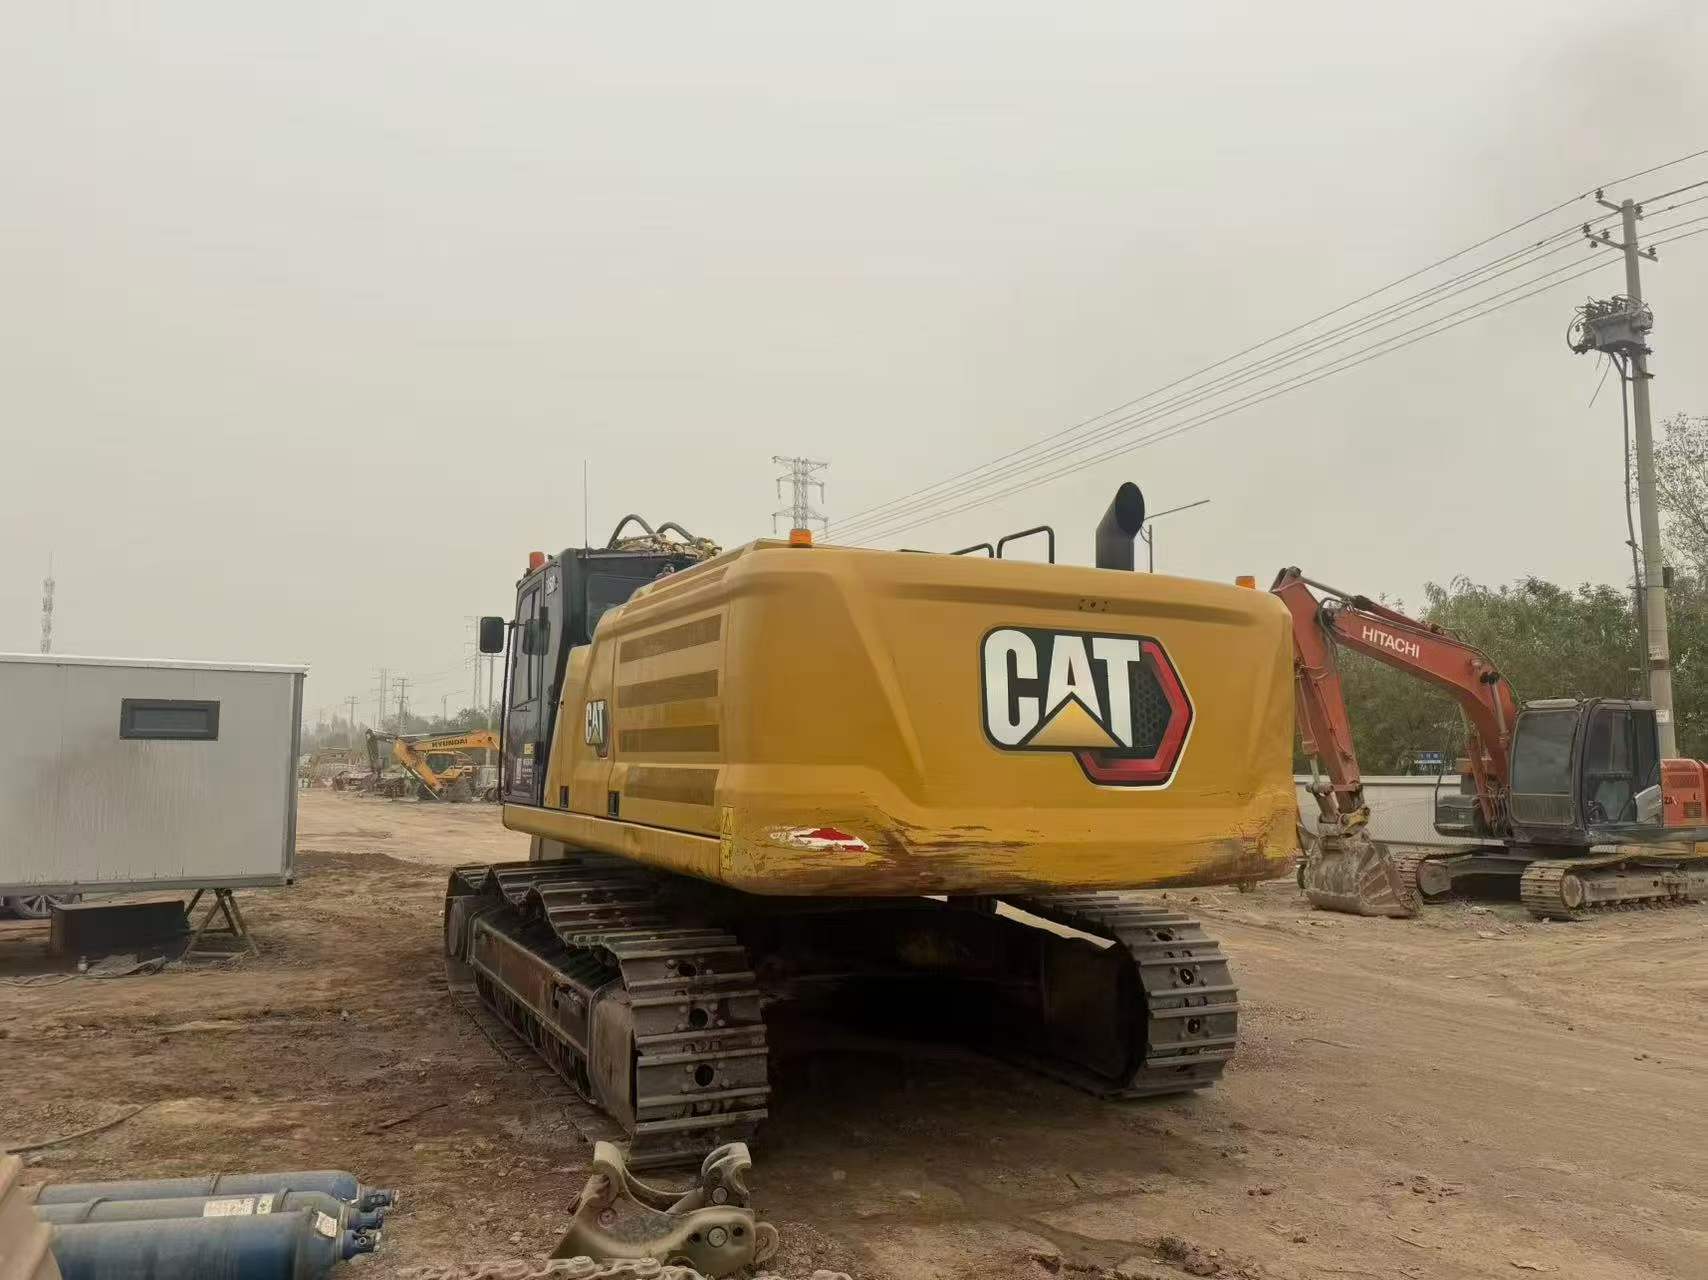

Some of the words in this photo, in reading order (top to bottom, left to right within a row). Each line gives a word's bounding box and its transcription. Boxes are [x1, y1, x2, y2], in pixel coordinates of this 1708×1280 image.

[1362, 625, 1420, 659] HITACHI
[984, 629, 1141, 748] CAT
[585, 700, 604, 744] CAT
[431, 738, 468, 748] HYUNDAI
